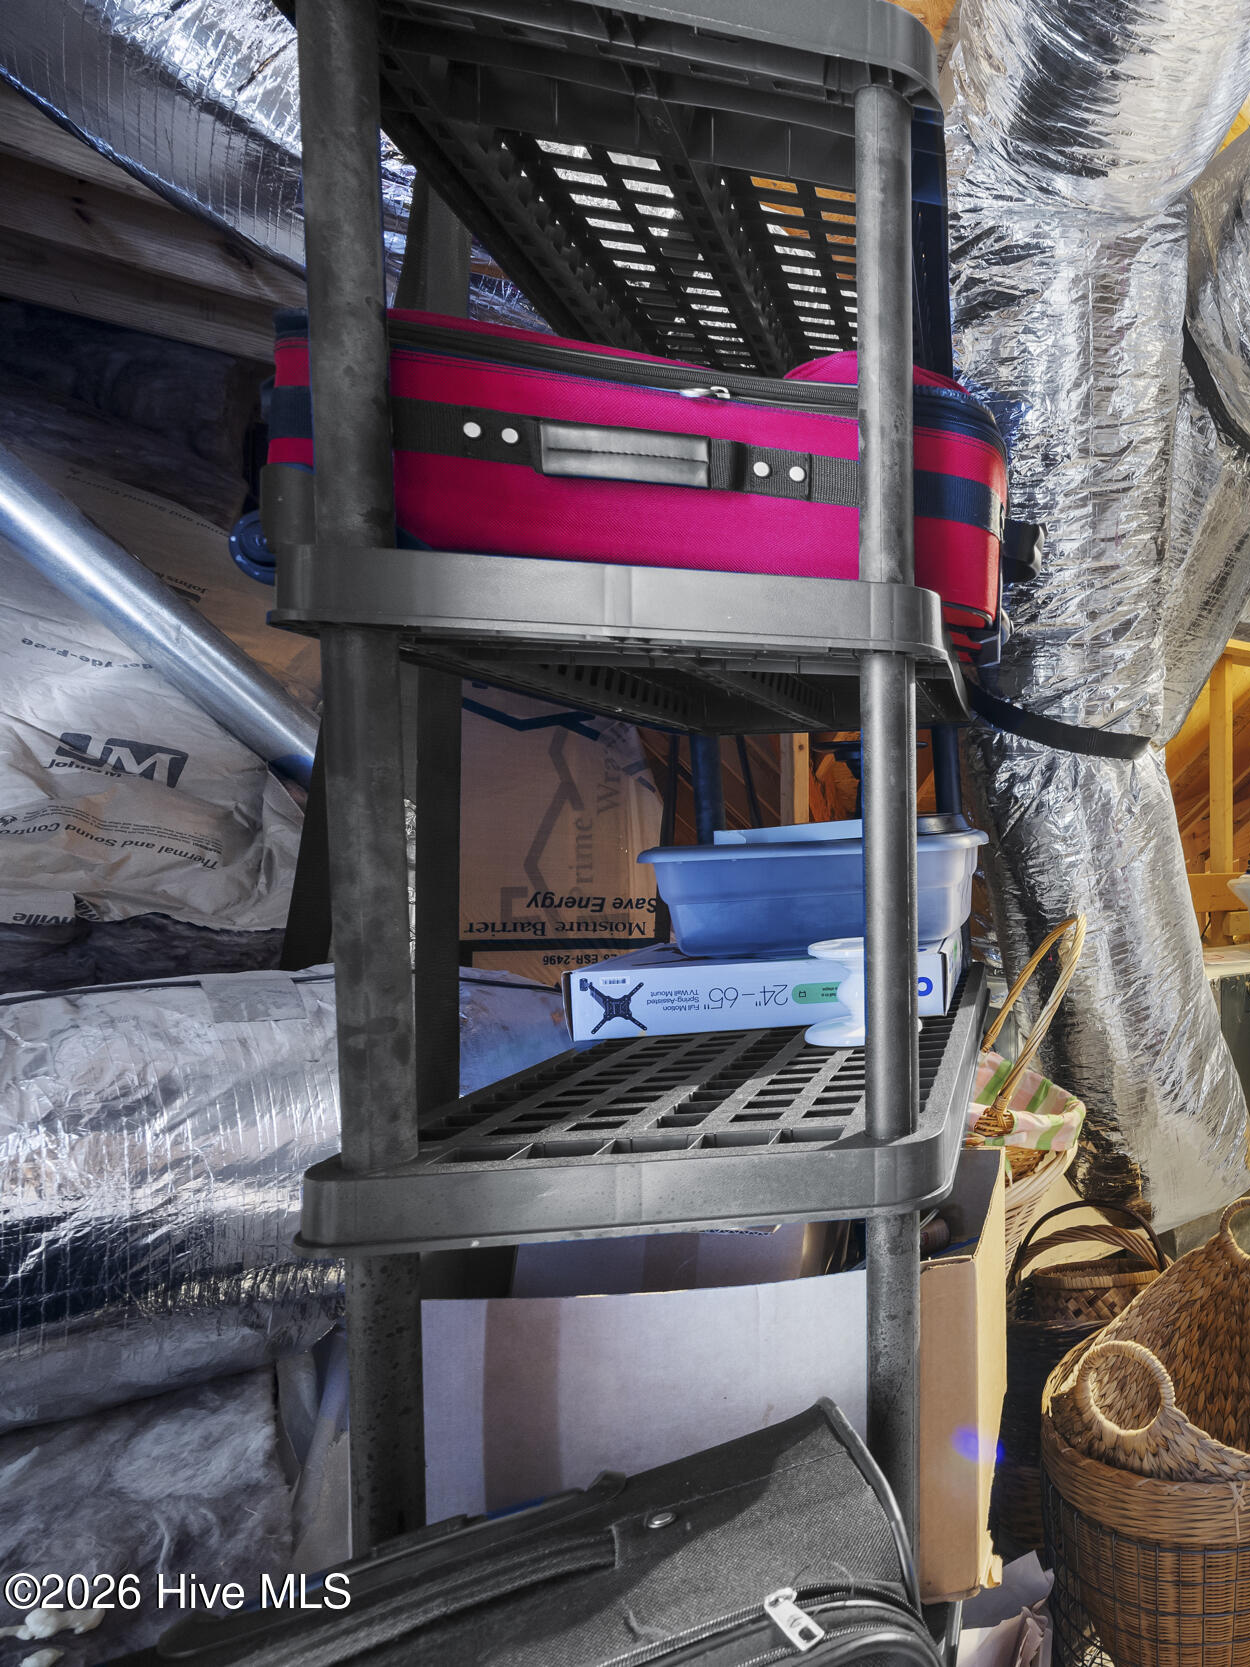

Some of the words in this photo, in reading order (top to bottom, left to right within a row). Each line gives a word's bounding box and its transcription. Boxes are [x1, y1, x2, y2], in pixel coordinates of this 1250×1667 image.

[64, 823, 118, 848] Sound
[121, 839, 155, 850] and
[157, 845, 220, 871] Thermal
[526, 891, 606, 914] Energy
[612, 897, 657, 914] Save
[463, 921, 546, 937] Barrier
[554, 921, 646, 937] Moisture
[647, 996, 700, 1006] Spring-Assisted
